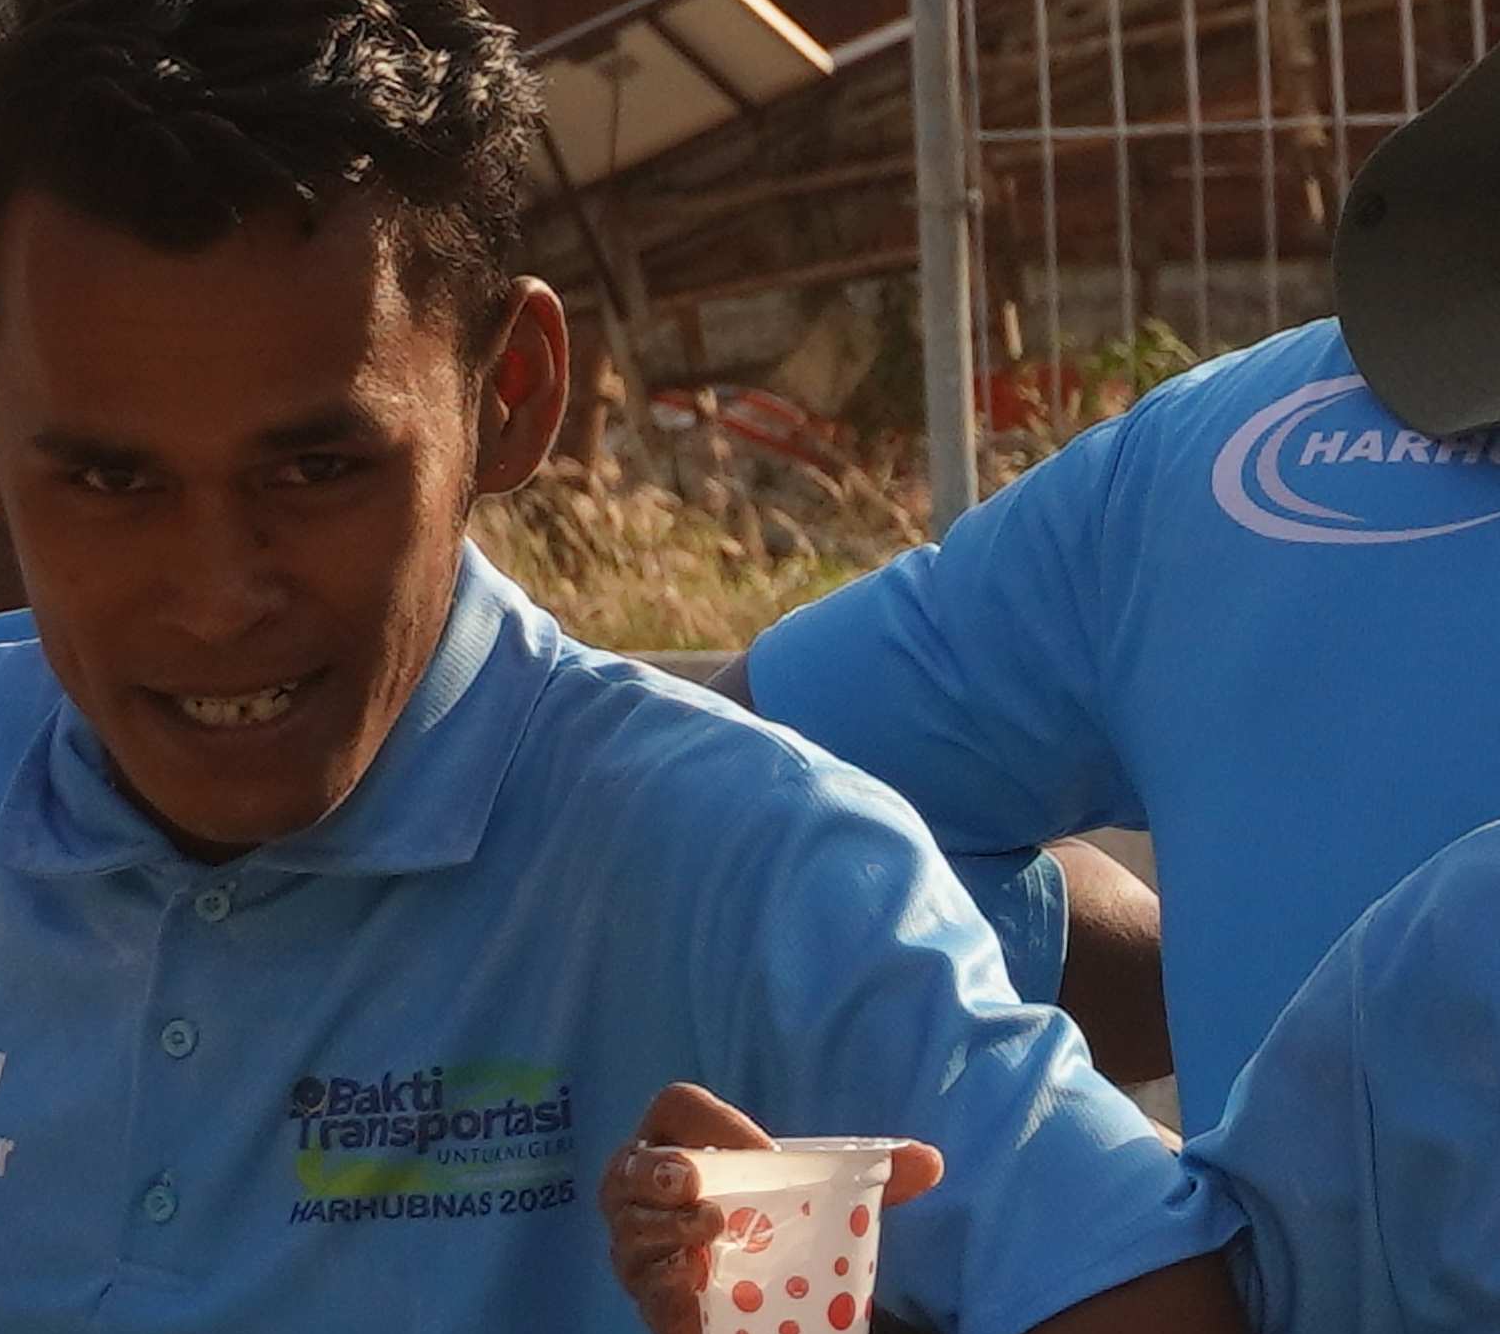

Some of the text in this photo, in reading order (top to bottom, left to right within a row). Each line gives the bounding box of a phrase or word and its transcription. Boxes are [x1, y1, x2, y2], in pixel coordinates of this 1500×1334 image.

[329, 1066, 443, 1115] Bakti
[291, 1086, 573, 1155] Transportasi
[290, 1178, 575, 1225] HARHUBNAS 2025
